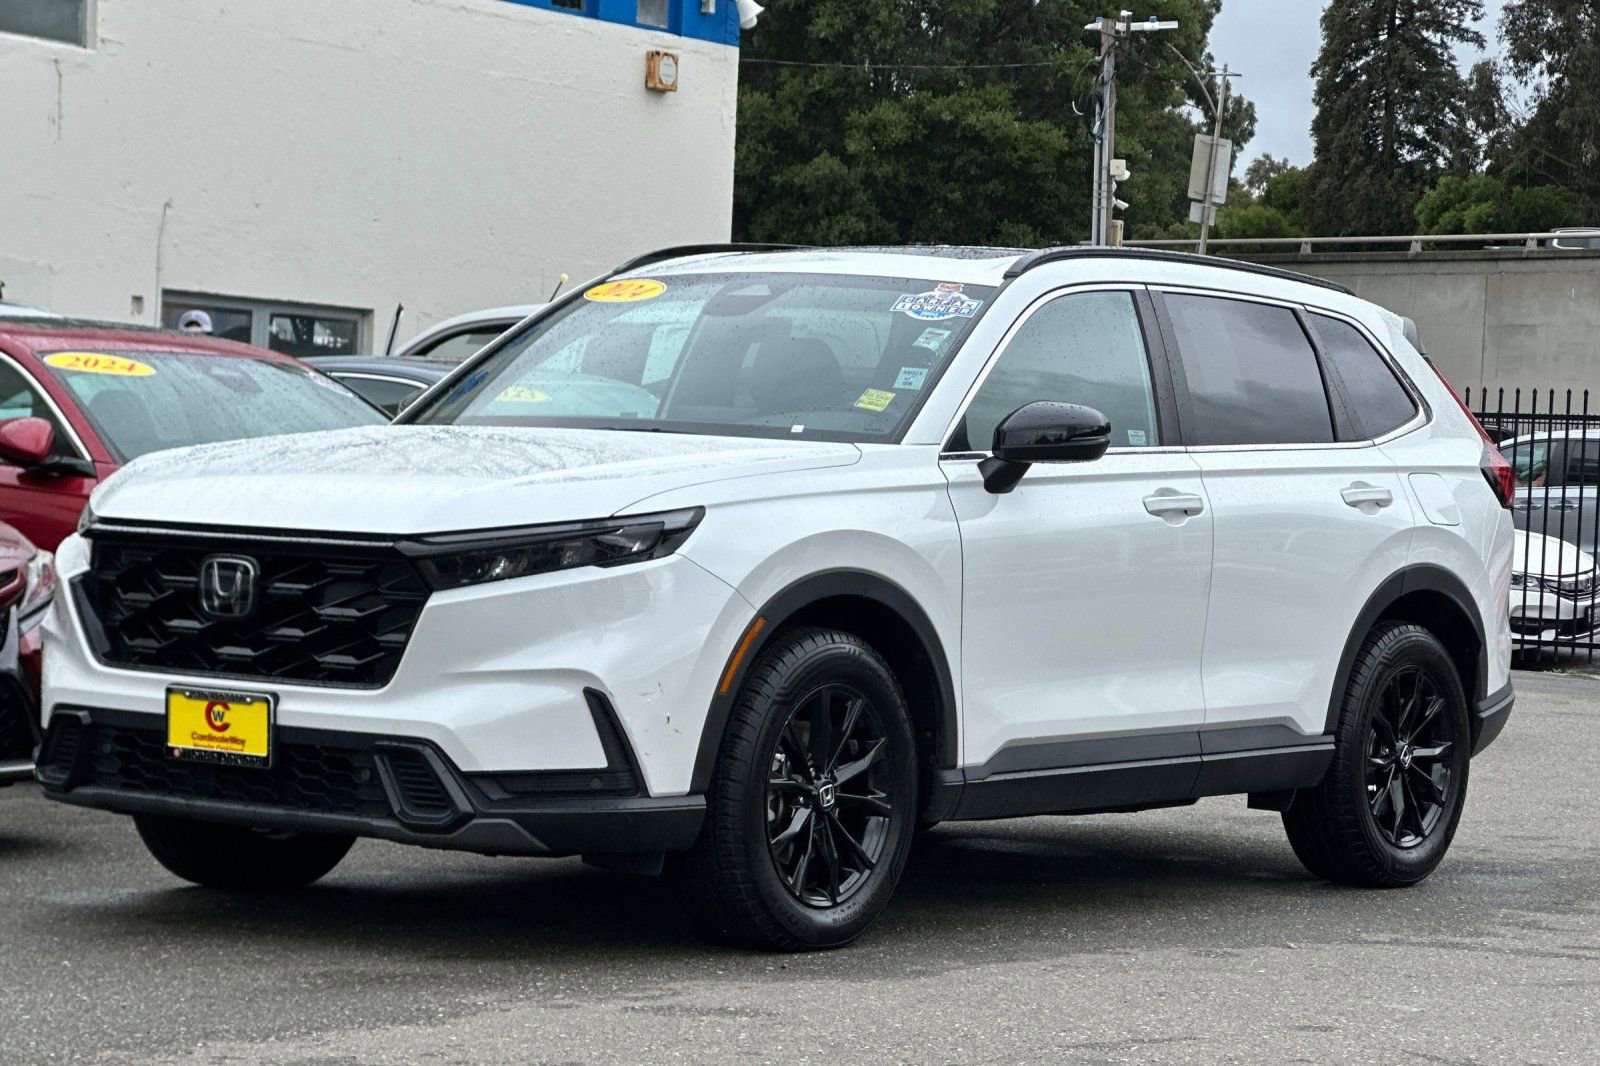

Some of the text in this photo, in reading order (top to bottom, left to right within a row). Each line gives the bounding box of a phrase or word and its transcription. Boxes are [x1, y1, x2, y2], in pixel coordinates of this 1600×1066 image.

[903, 297, 976, 309] CARFAX
[912, 304, 970, 315] OWNER
[64, 356, 137, 372] 2024
[212, 709, 226, 722] W
[191, 731, 246, 748] CardinaleWay
